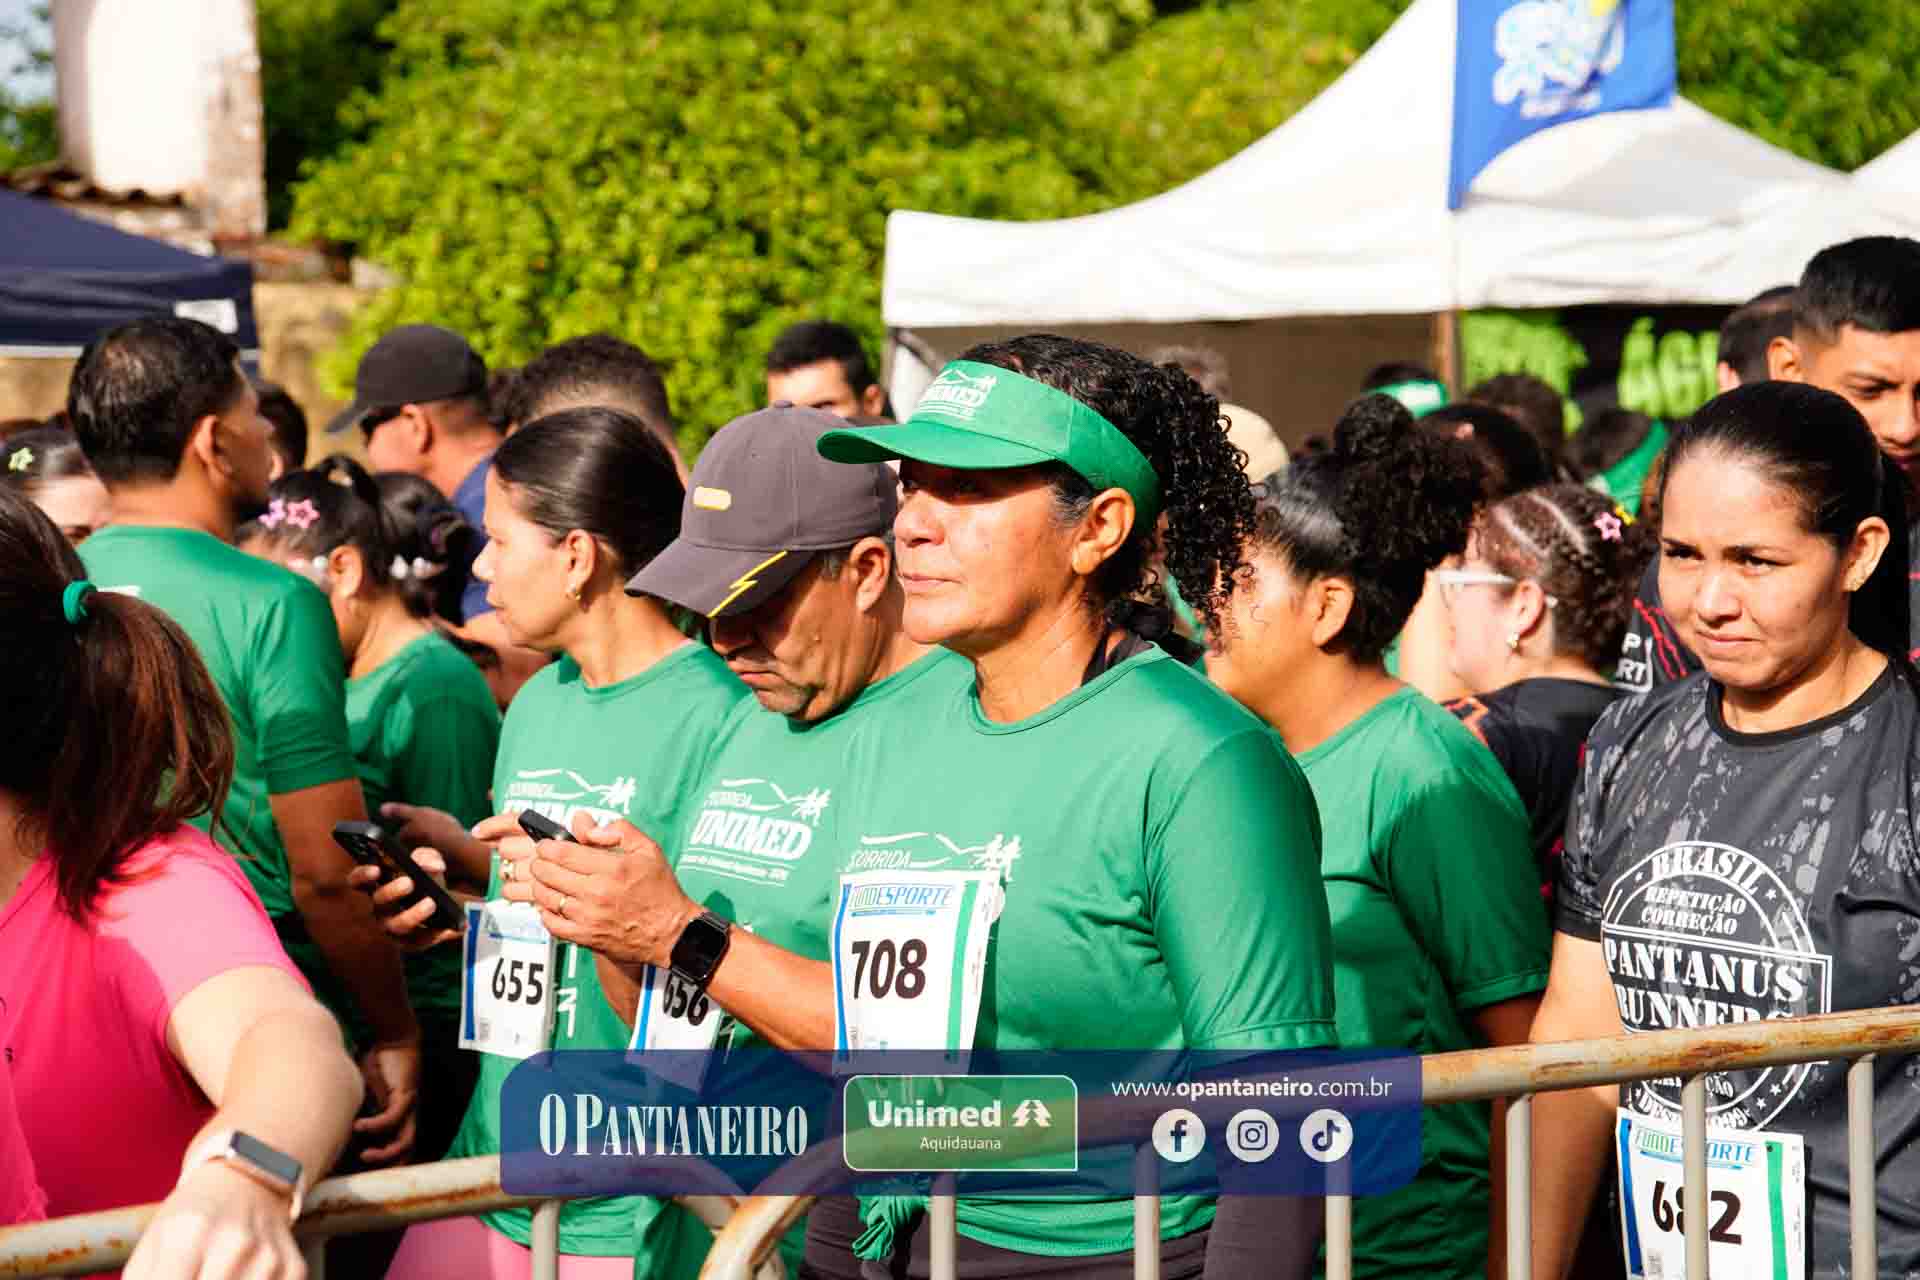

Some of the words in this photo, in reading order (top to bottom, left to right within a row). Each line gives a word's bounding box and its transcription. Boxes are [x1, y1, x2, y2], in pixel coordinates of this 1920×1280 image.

[690, 809, 812, 860] UNIMED
[1651, 847, 1767, 895] BRASIL
[1640, 906, 1737, 937] CORREÇÃO
[1644, 886, 1747, 916] REPETIÇÃO
[491, 957, 545, 1005] 655
[851, 938, 928, 1000] 708
[1603, 937, 1804, 1003] PANTANUS
